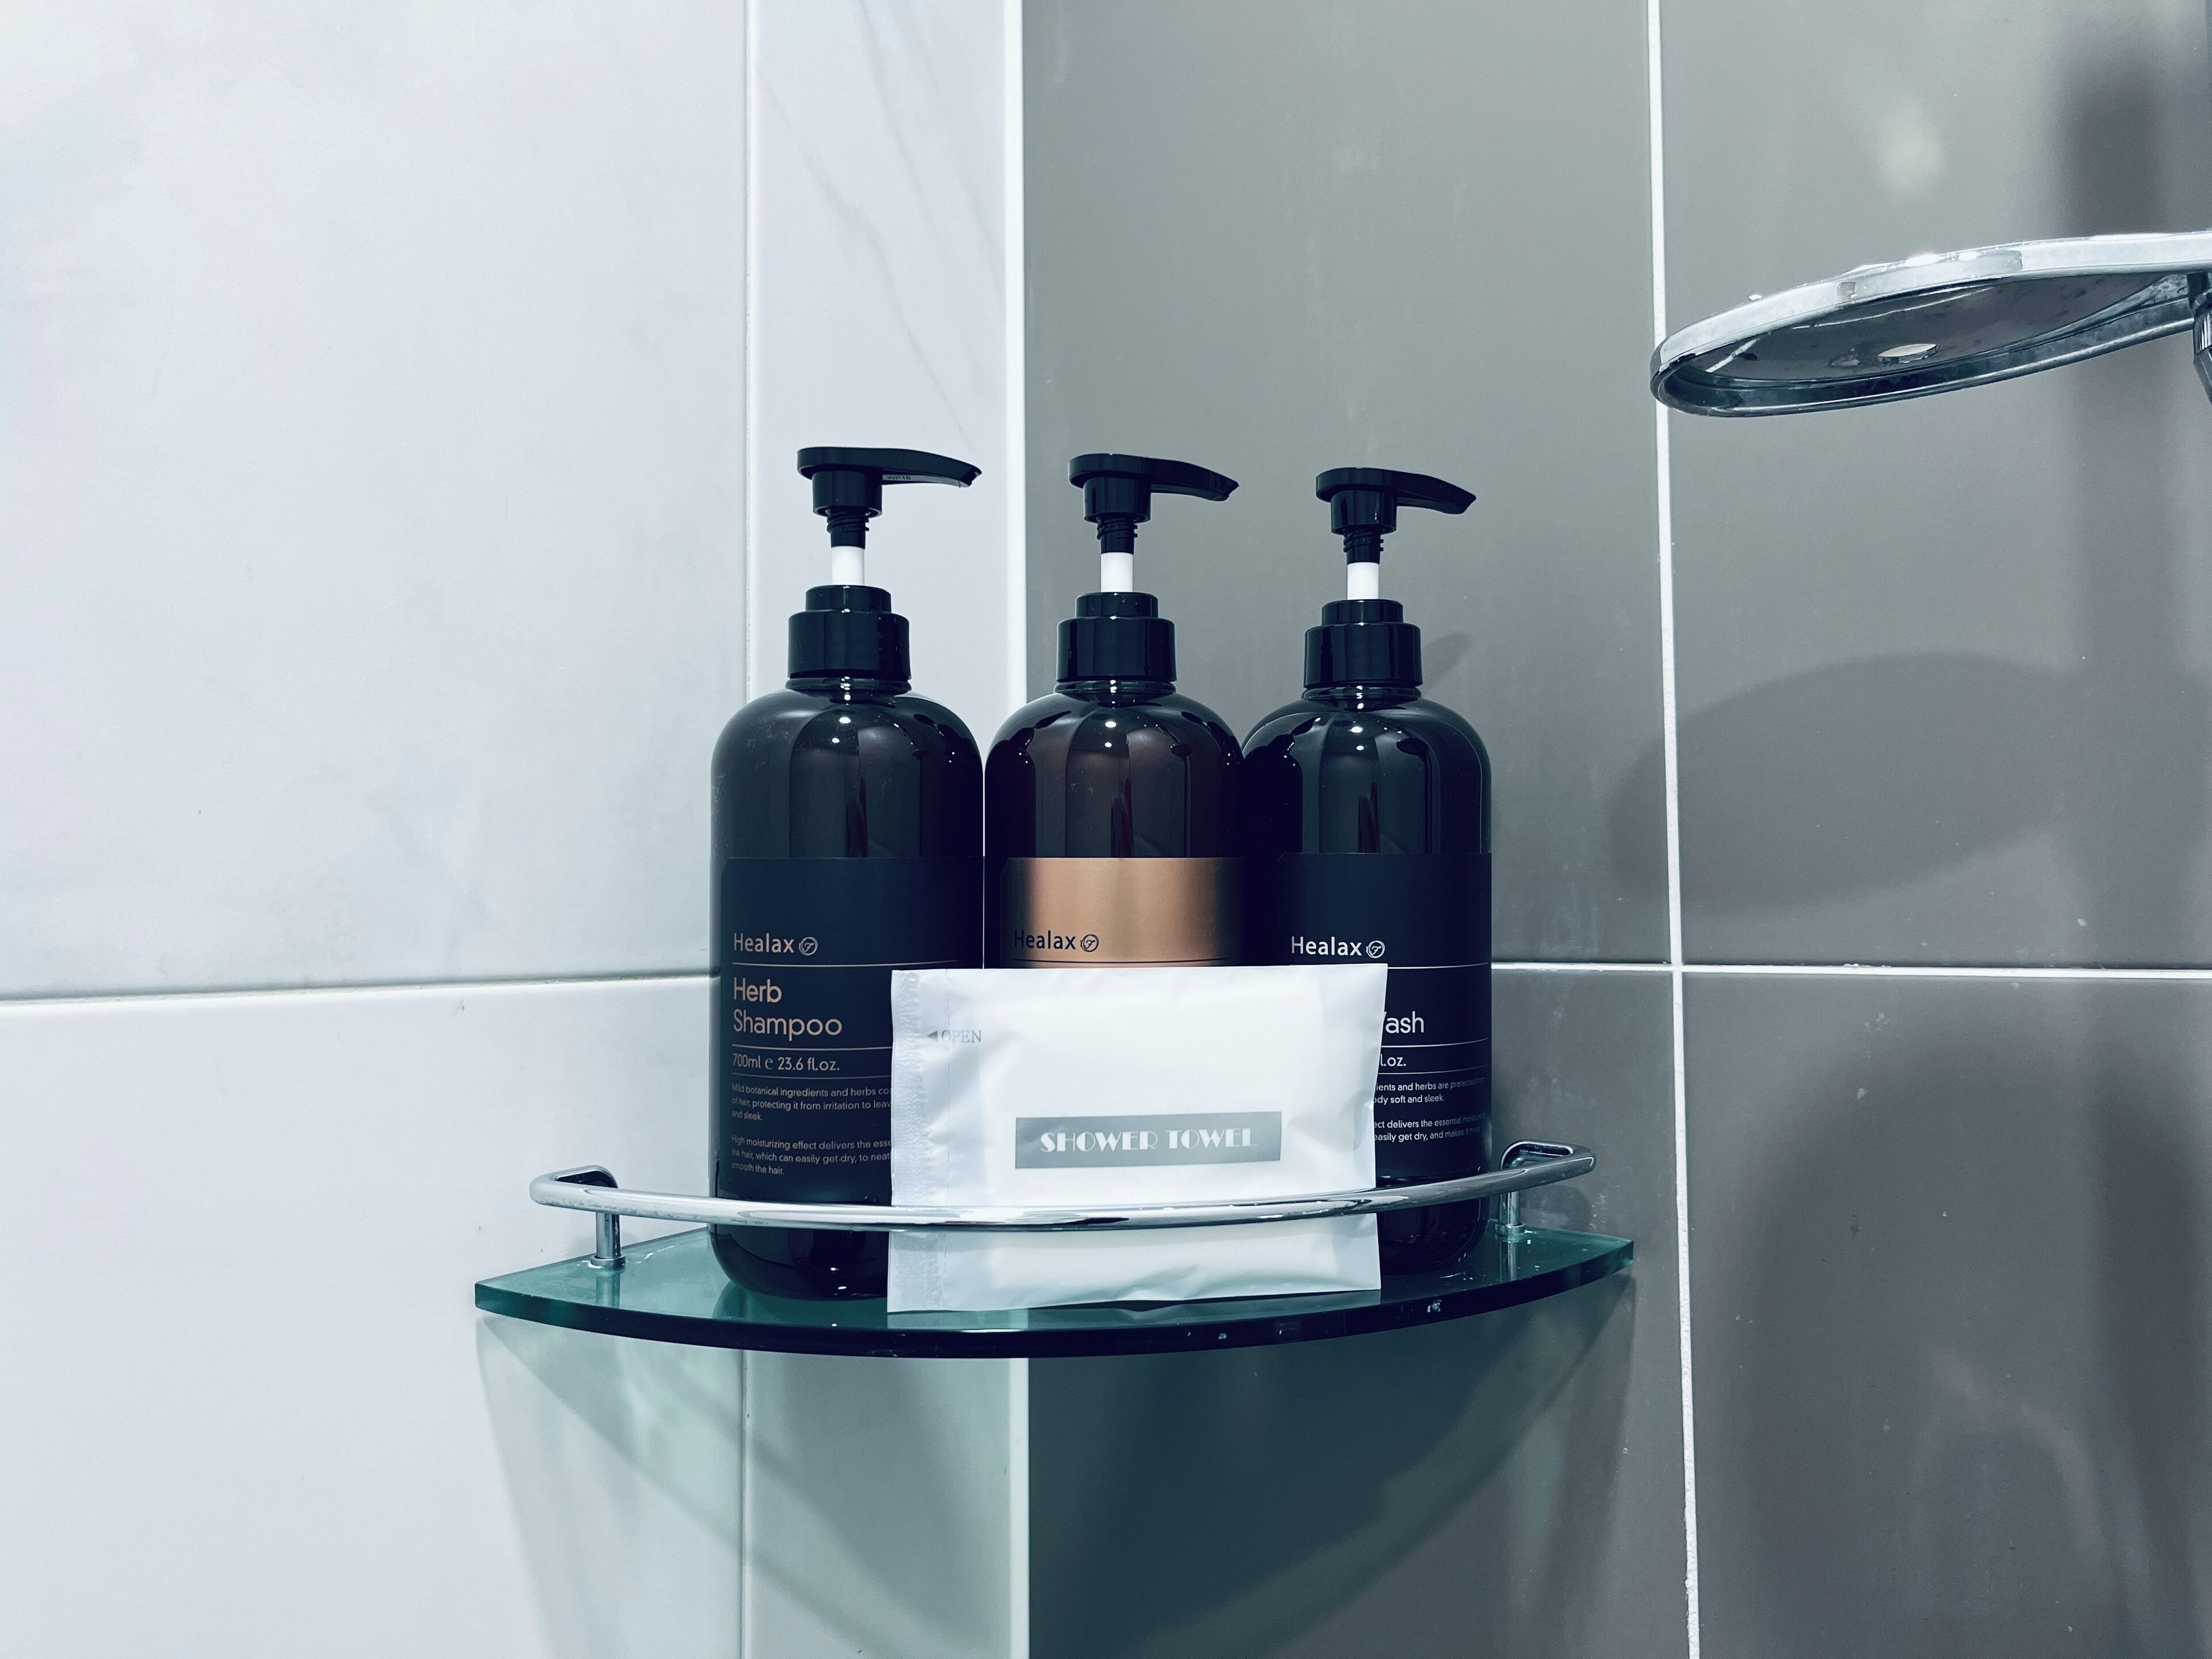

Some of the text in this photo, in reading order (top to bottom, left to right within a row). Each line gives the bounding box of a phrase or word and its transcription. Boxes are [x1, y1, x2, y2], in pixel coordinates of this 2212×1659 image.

[733, 933, 794, 953] Healax
[1014, 929, 1077, 950] Healax
[1291, 936, 1362, 956] Healax
[733, 977, 782, 1003] Herb
[733, 1009, 842, 1041] Shampoo
[1383, 1010, 1425, 1034] ash
[941, 1029, 982, 1043] OPEN
[733, 1053, 762, 1069] 700ml
[778, 1056, 804, 1071] 23.6
[807, 1056, 840, 1071] fl.oz.
[732, 1083, 745, 1093] Mild
[746, 1085, 779, 1096] botanical
[781, 1088, 829, 1099] ingredients
[831, 1088, 849, 1096] and
[851, 1087, 876, 1096] herbs
[1397, 1082, 1414, 1091] and
[1415, 1082, 1437, 1090] herbs
[752, 1100, 791, 1112] protecting
[793, 1101, 798, 1109] it
[801, 1101, 821, 1110] from
[823, 1101, 859, 1109] irritation
[1390, 1094, 1406, 1103] soft
[1407, 1094, 1423, 1103] and
[1425, 1093, 1445, 1103] sleek.
[744, 1111, 763, 1120] sleek.
[1387, 1120, 1419, 1128] delivers
[1421, 1119, 1433, 1127] the
[1434, 1116, 1462, 1126] essential
[732, 1135, 745, 1146] High
[747, 1138, 790, 1150] moisturizing
[792, 1141, 816, 1150] effect
[819, 1141, 855, 1149] delivers
[857, 1140, 871, 1148] the
[1040, 1127, 1258, 1152] SHOWER TOWEL
[1398, 1133, 1412, 1142] get
[1414, 1132, 1429, 1142] dry,
[1430, 1130, 1444, 1139] and
[1445, 1129, 1464, 1137] makes
[741, 1149, 754, 1160] hair,
[756, 1152, 777, 1161] which
[796, 1154, 821, 1165] easily
[823, 1155, 838, 1165] get
[840, 1154, 857, 1164] dry,
[755, 1164, 767, 1173] the
[768, 1165, 784, 1175] hair.
